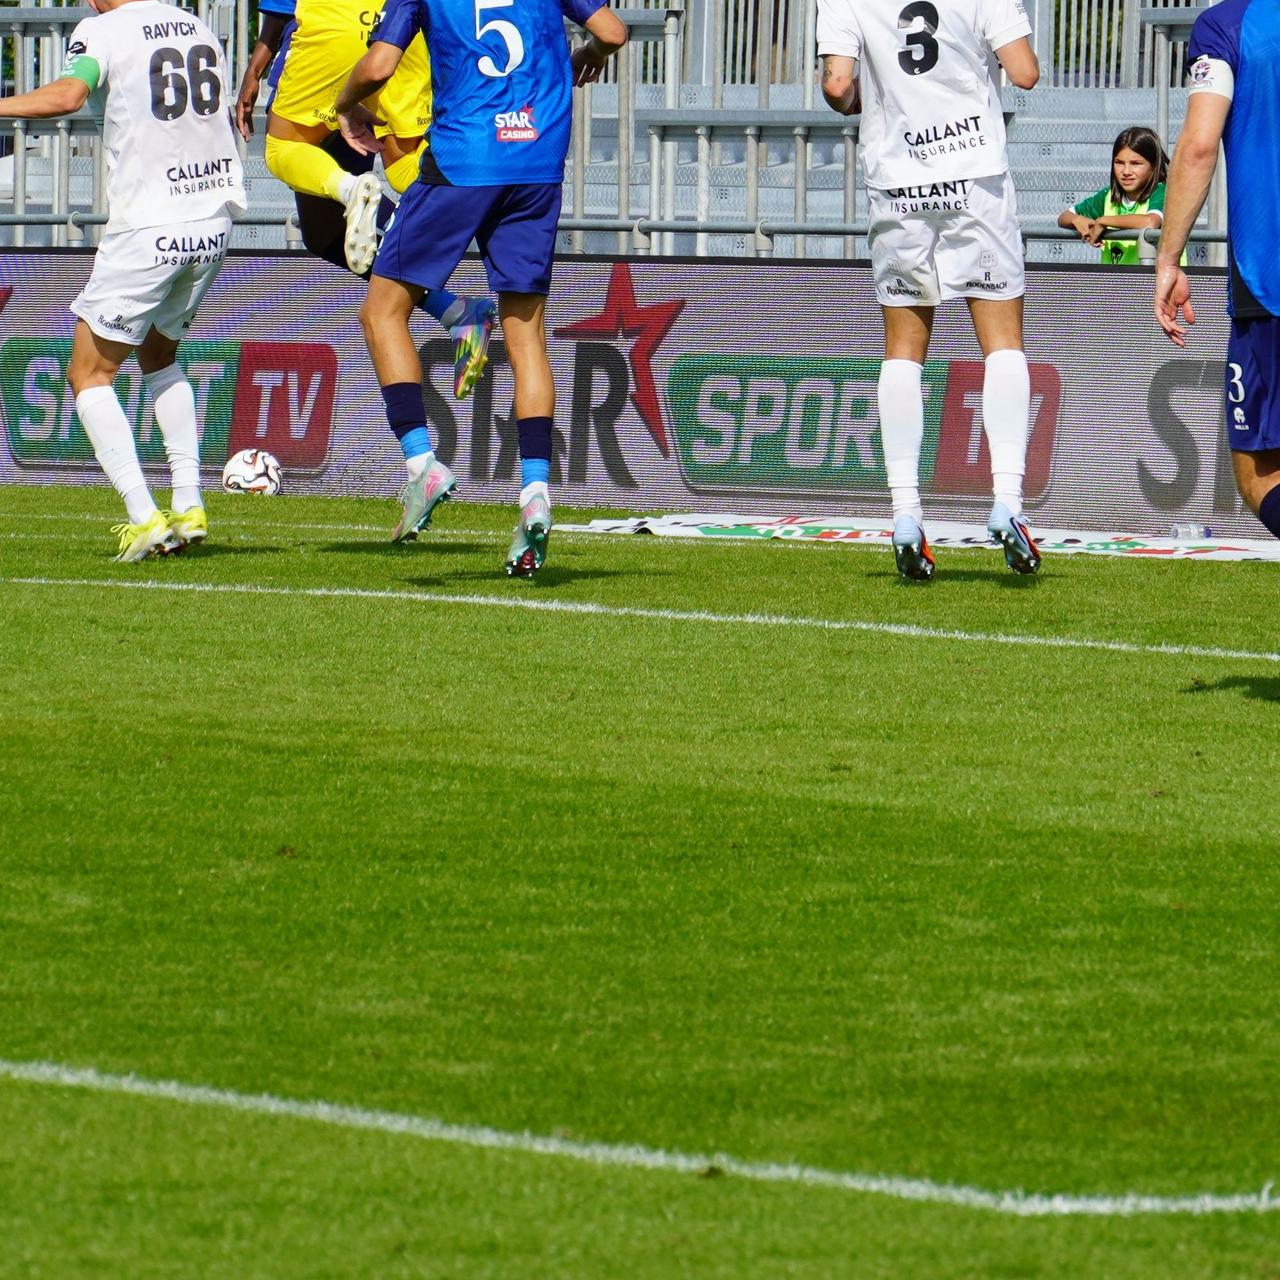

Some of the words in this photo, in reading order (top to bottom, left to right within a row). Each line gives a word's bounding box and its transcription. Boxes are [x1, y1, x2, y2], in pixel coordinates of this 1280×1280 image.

[142, 20, 197, 41] RAVYCH
[897, 0, 939, 76] 3
[149, 44, 221, 121] 66
[494, 112, 531, 129] STAR
[904, 115, 981, 148] CALLANT
[500, 130, 534, 139] CASINO
[908, 137, 986, 160] INSURANCE
[166, 158, 233, 183] CALLANT
[169, 175, 235, 196] INSURANCE
[886, 179, 969, 199] CALLANT
[890, 198, 969, 214] INSURANCE
[155, 231, 225, 254] CALLANT
[155, 251, 223, 267] INSURANCE
[966, 280, 1008, 290] RODENBACH
[1228, 363, 1245, 402] 3
[252, 371, 321, 439] TV
[693, 375, 931, 470] SPOR
